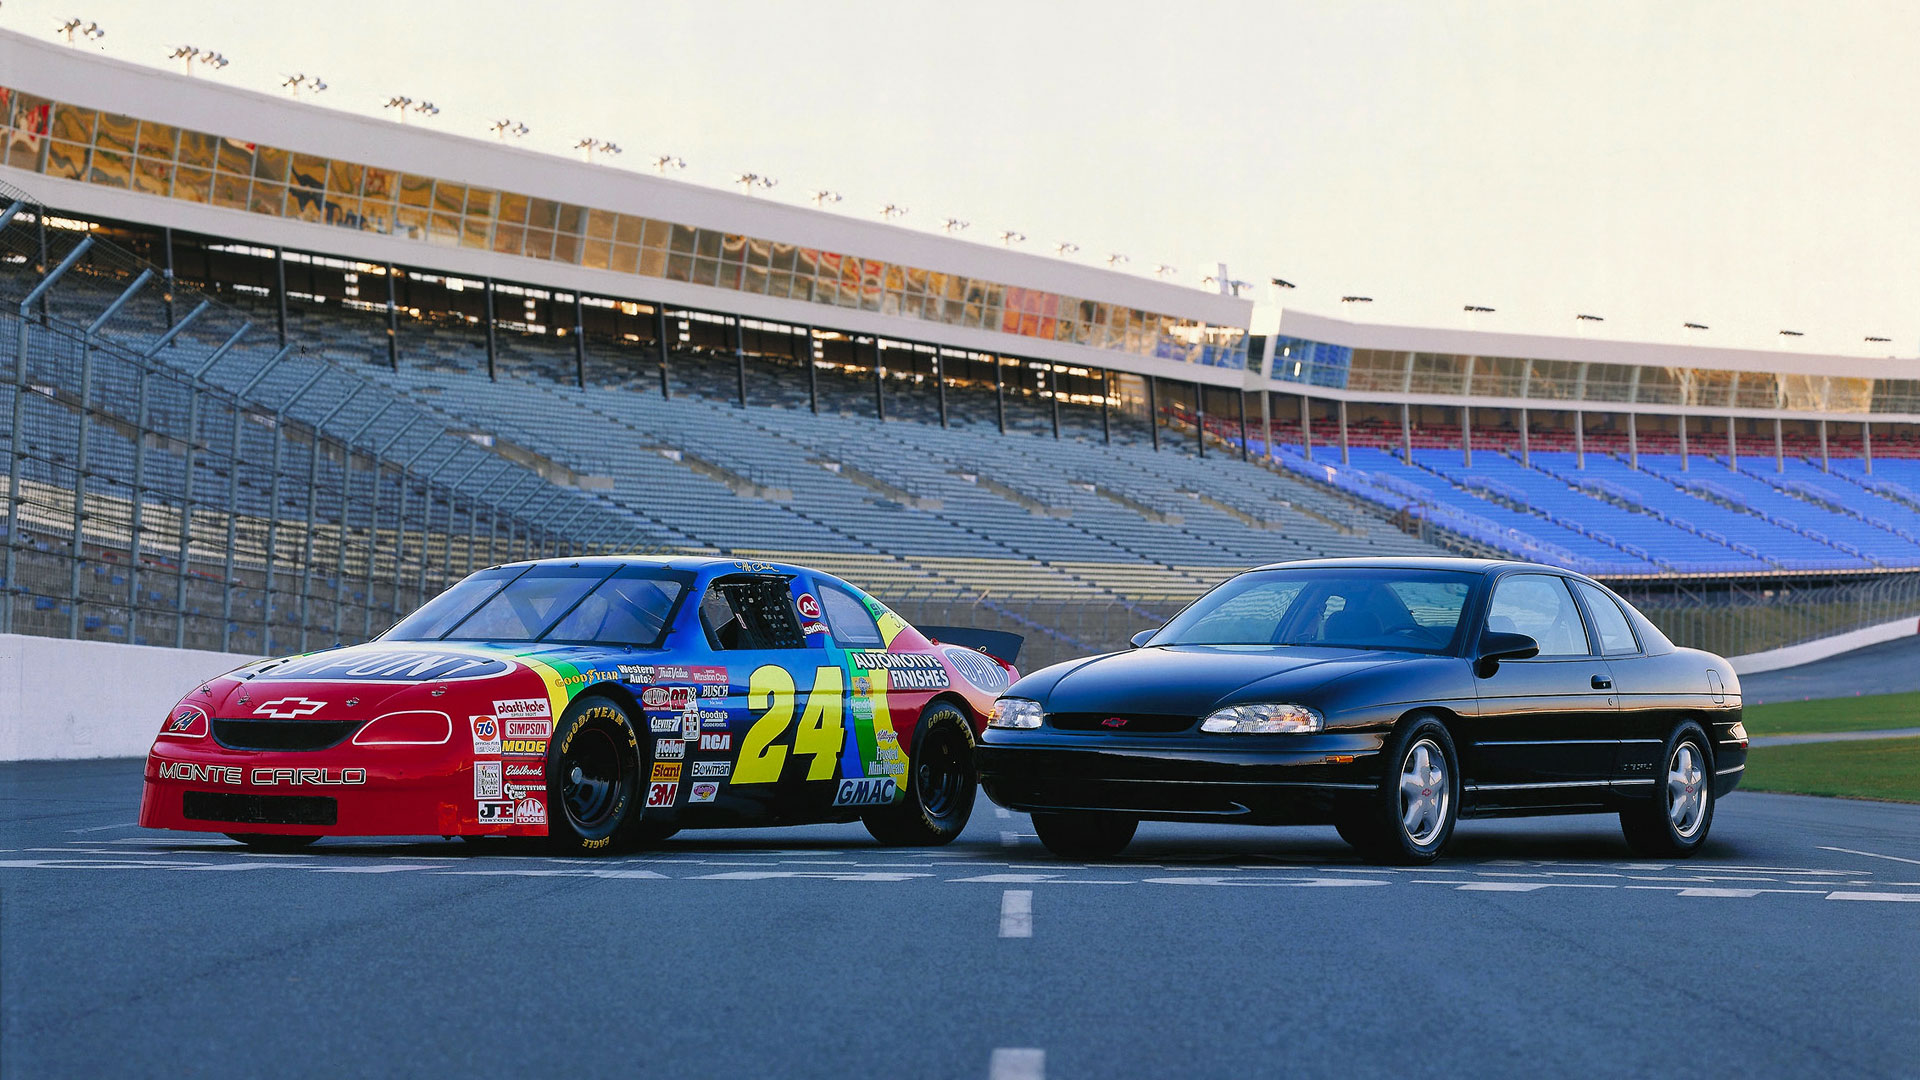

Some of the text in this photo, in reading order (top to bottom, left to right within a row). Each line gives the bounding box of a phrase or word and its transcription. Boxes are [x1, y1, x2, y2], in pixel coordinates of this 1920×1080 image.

[803, 600, 818, 613] AC
[307, 652, 494, 678] PONT
[852, 652, 943, 669] AUTOMOTIVE
[617, 664, 655, 675] Western
[629, 674, 649, 684] Auto
[693, 672, 727, 682] Winston Cup
[890, 669, 950, 688] FINISHES
[702, 685, 729, 697] BUSCH
[497, 700, 545, 714] plasti-kote
[169, 711, 201, 731] 24
[700, 710, 729, 722] Goody's
[477, 721, 494, 735] 76
[509, 723, 547, 735] SIMPSON
[730, 664, 845, 784] 24
[502, 740, 547, 753] MOOG
[657, 739, 685, 754] Holley
[700, 734, 731, 749] RCA
[876, 746, 898, 760] Frosted
[159, 762, 367, 786] MONTE CARLO
[505, 765, 543, 776] Edelbrock
[653, 764, 680, 777] Stant
[693, 763, 729, 775] Bowman
[868, 761, 905, 775] Mini-Wheats
[481, 786, 498, 795] Year
[504, 783, 547, 794] COMPETITION
[648, 784, 677, 806] 3M
[838, 779, 895, 804] GMAC
[480, 804, 513, 818] JE
[517, 800, 544, 816] MAC
[582, 836, 610, 848] EAGLE
